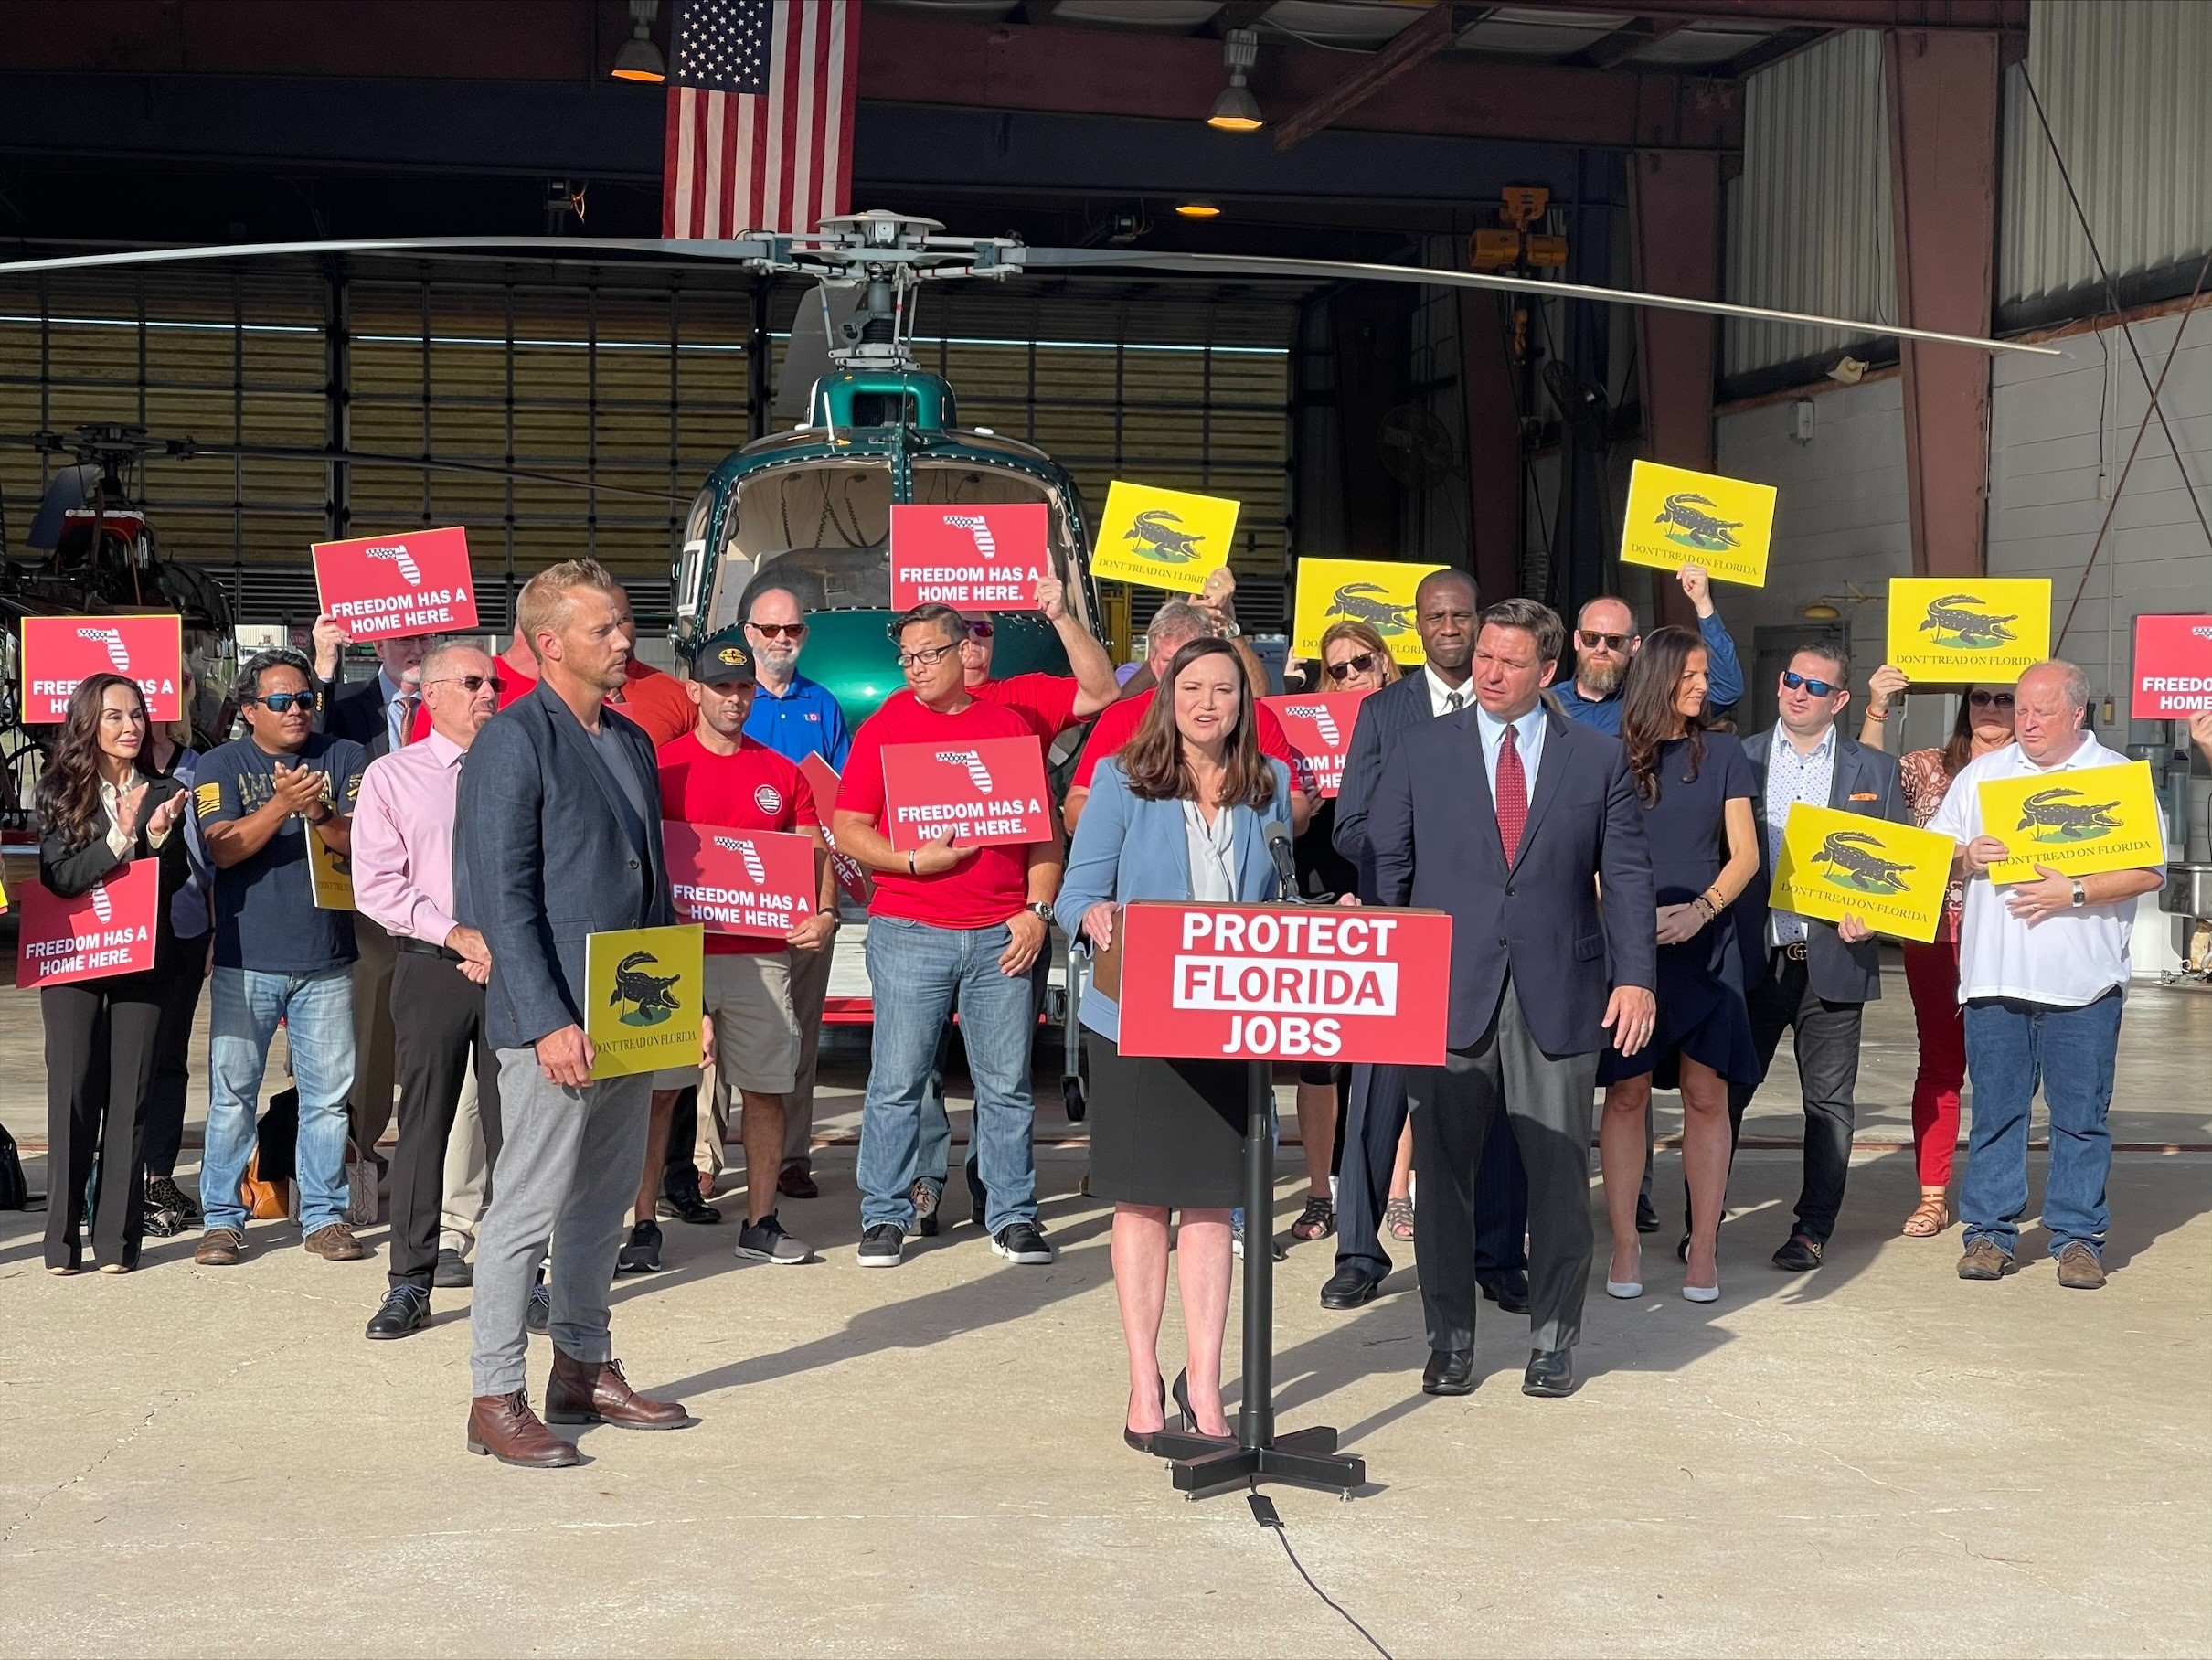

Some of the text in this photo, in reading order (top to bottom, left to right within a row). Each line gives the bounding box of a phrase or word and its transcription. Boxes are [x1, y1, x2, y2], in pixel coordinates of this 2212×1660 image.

[1099, 559, 1207, 584] DONT TREAD ON FLORID
[1632, 544, 1757, 575] DONT TREAD ON FLORIDA
[899, 566, 1039, 583] FREEDOM HAS A
[330, 587, 467, 619] FREEDOM HAS A
[918, 585, 1024, 601] HOME HERE.
[351, 608, 454, 633] HOME HERE.
[1303, 639, 1318, 648] DO
[1390, 644, 1424, 654] FLORI
[1896, 654, 1929, 665] DONT
[1930, 655, 1968, 665] TREAD
[1970, 656, 1986, 665] ON
[33, 680, 82, 696] FREE
[161, 678, 174, 695] A
[2143, 677, 2212, 692] FREEDO
[2160, 696, 2212, 710] HOME
[897, 798, 1041, 823] FREEDOM HAS A
[974, 818, 1027, 836] HERE.
[2033, 850, 2075, 863] TREAD
[2077, 846, 2095, 857] ON
[2098, 840, 2151, 855] FLORIDA
[673, 884, 809, 912] FREEDOM HAS A
[1781, 882, 1928, 923] DONT TREAD ON FLORIDA
[690, 904, 794, 929] HOME HERE.
[26, 925, 148, 959] FREEDOM HAS A
[1182, 912, 1398, 957] PROTECT
[39, 948, 133, 976] HOME HERE.
[1184, 964, 1385, 1006] FLORIDA
[594, 1031, 696, 1053] DONT TREAD ON FLORIDA
[1222, 1016, 1342, 1057] JOBS
